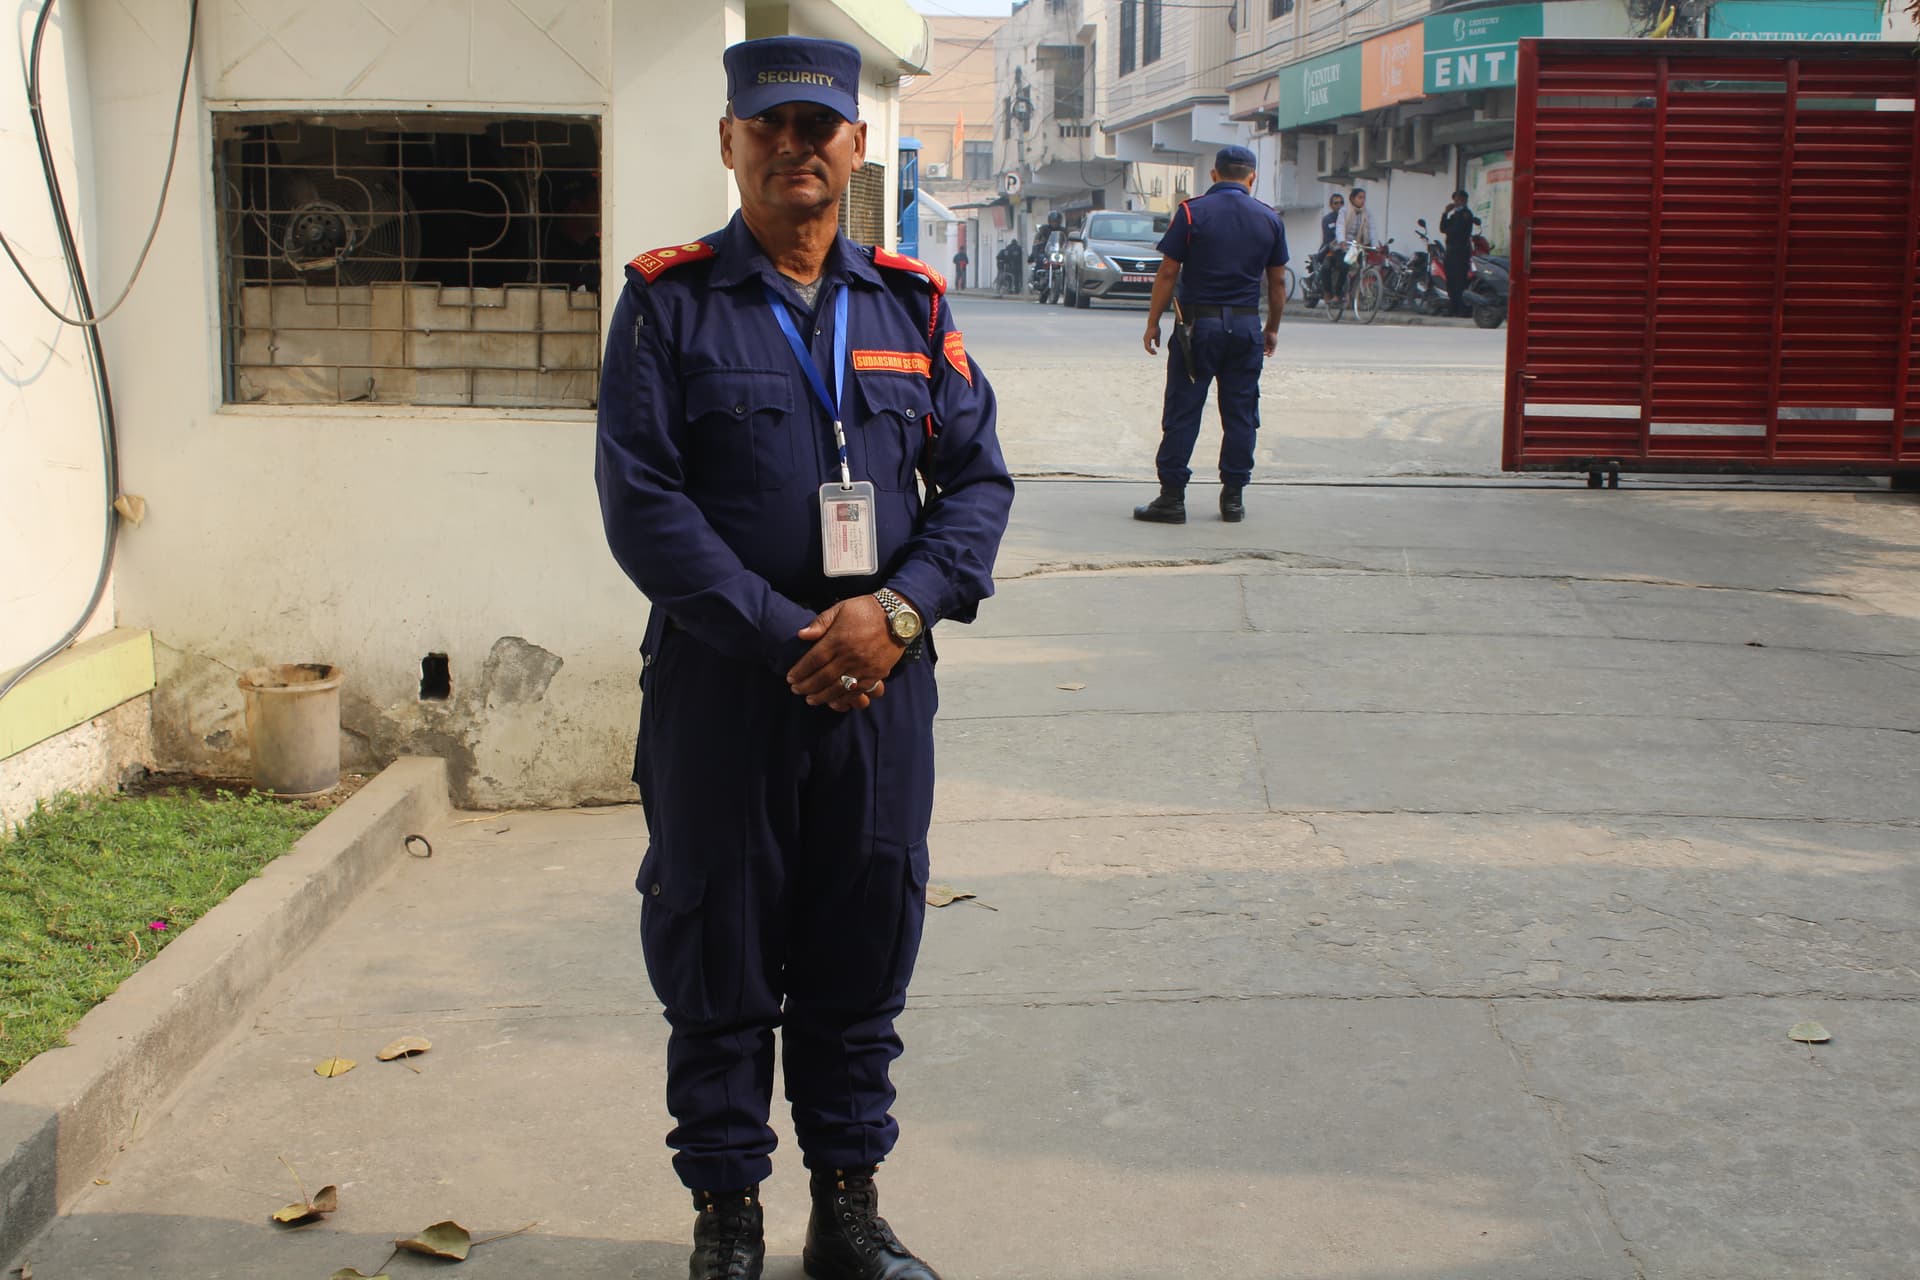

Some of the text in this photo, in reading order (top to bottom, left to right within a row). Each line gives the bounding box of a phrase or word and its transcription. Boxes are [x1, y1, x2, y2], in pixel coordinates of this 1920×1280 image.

[1469, 17, 1499, 27] CENTURY
[1469, 27, 1487, 36] BANK
[757, 71, 834, 88] SECURITY
[1311, 63, 1340, 87] CENTURY
[1311, 87, 1328, 107] BANK
[856, 356, 903, 369] SUDARSHAN
